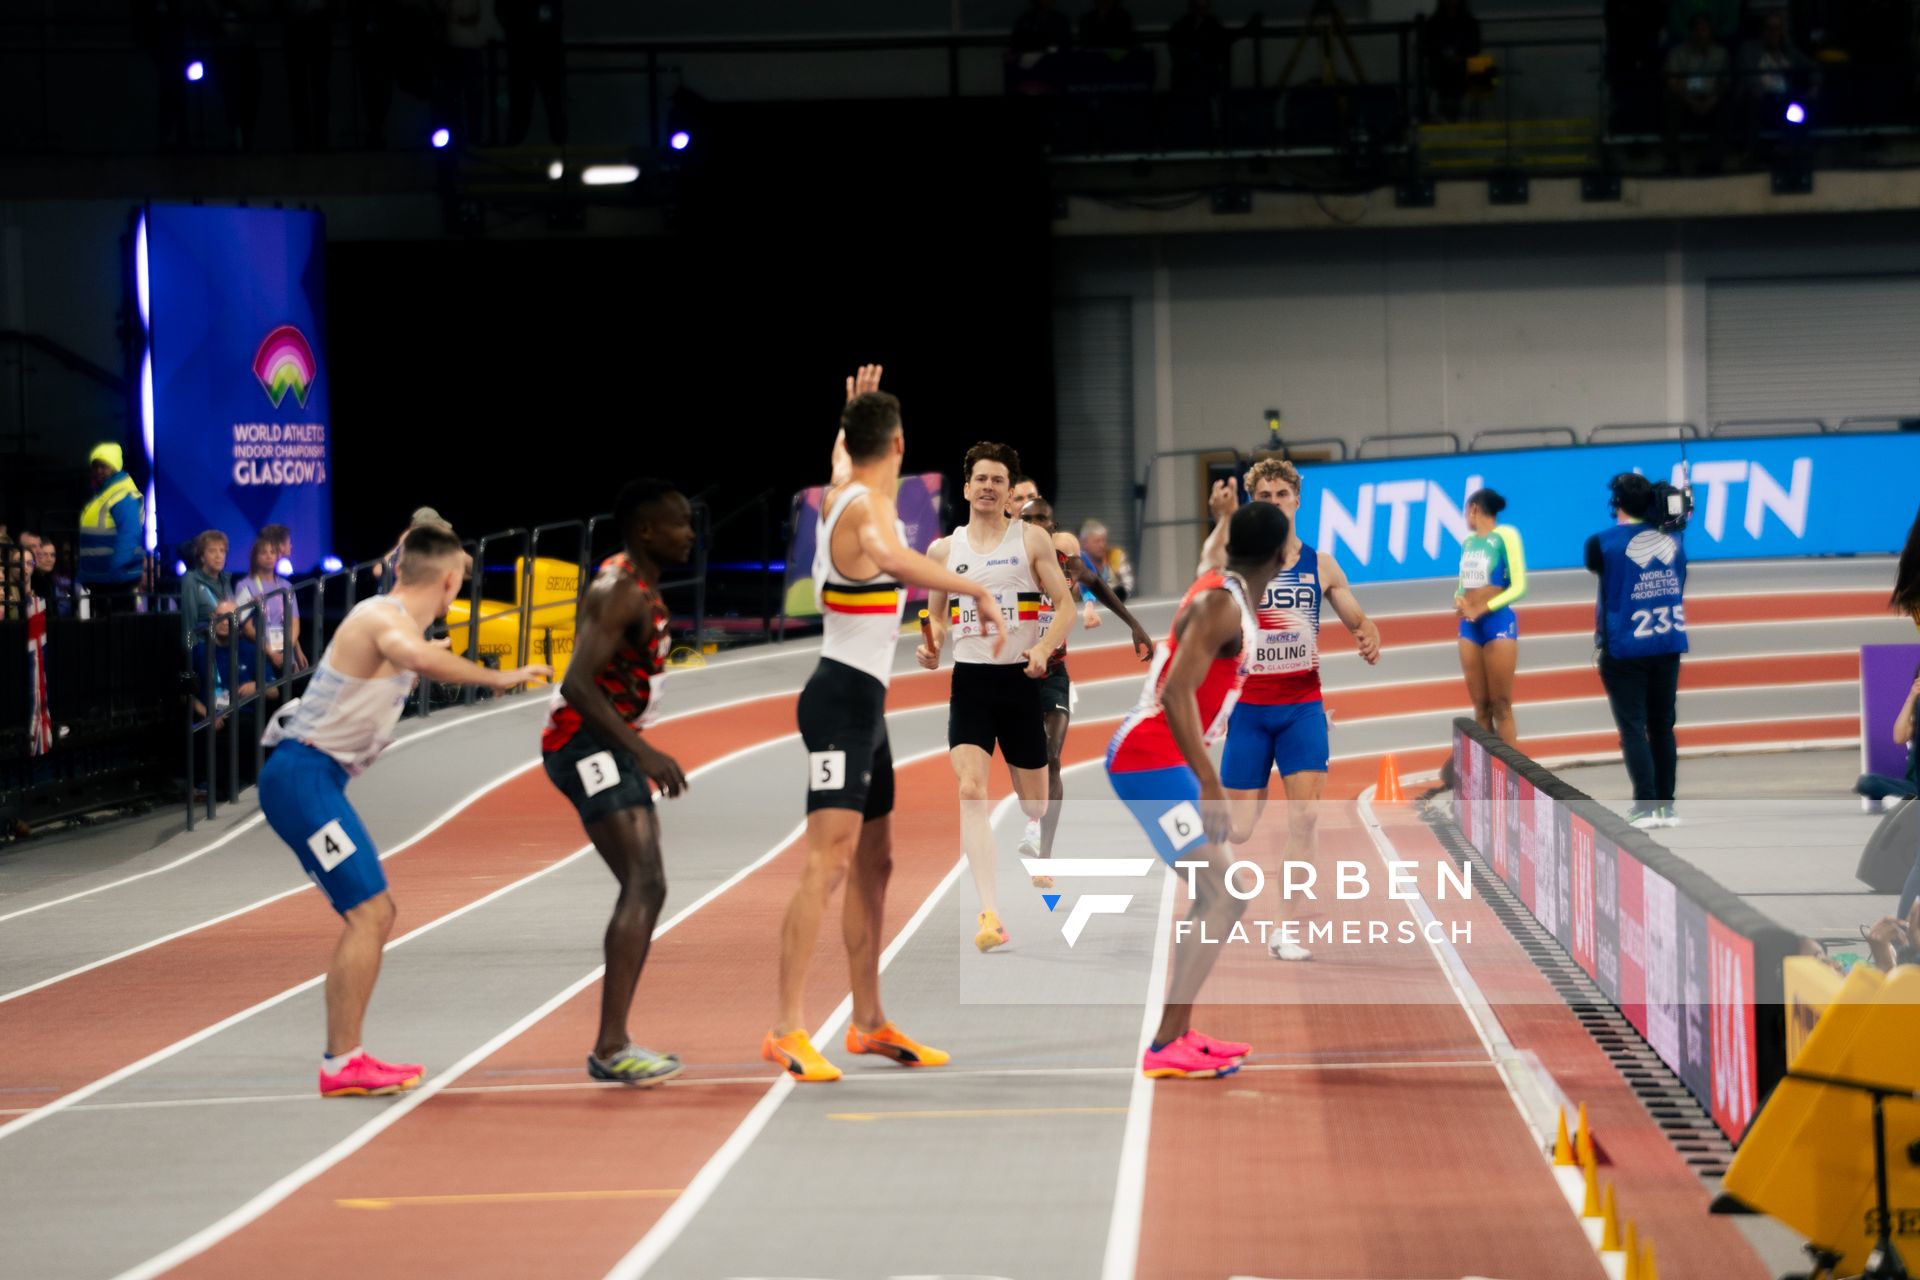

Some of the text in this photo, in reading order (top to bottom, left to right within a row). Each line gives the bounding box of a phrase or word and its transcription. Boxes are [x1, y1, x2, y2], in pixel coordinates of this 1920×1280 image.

[233, 424, 281, 441] WORLD
[233, 445, 273, 458] INDOOR
[233, 460, 315, 485] GLASGOW
[1317, 474, 1483, 566] NTN
[1640, 569, 1673, 581] WORLD
[1631, 605, 1686, 638] 235
[1256, 644, 1306, 661] BOLING
[591, 762, 604, 784] 3
[822, 760, 831, 782] 5
[1175, 817, 1191, 837] 6
[325, 834, 340, 853] 4
